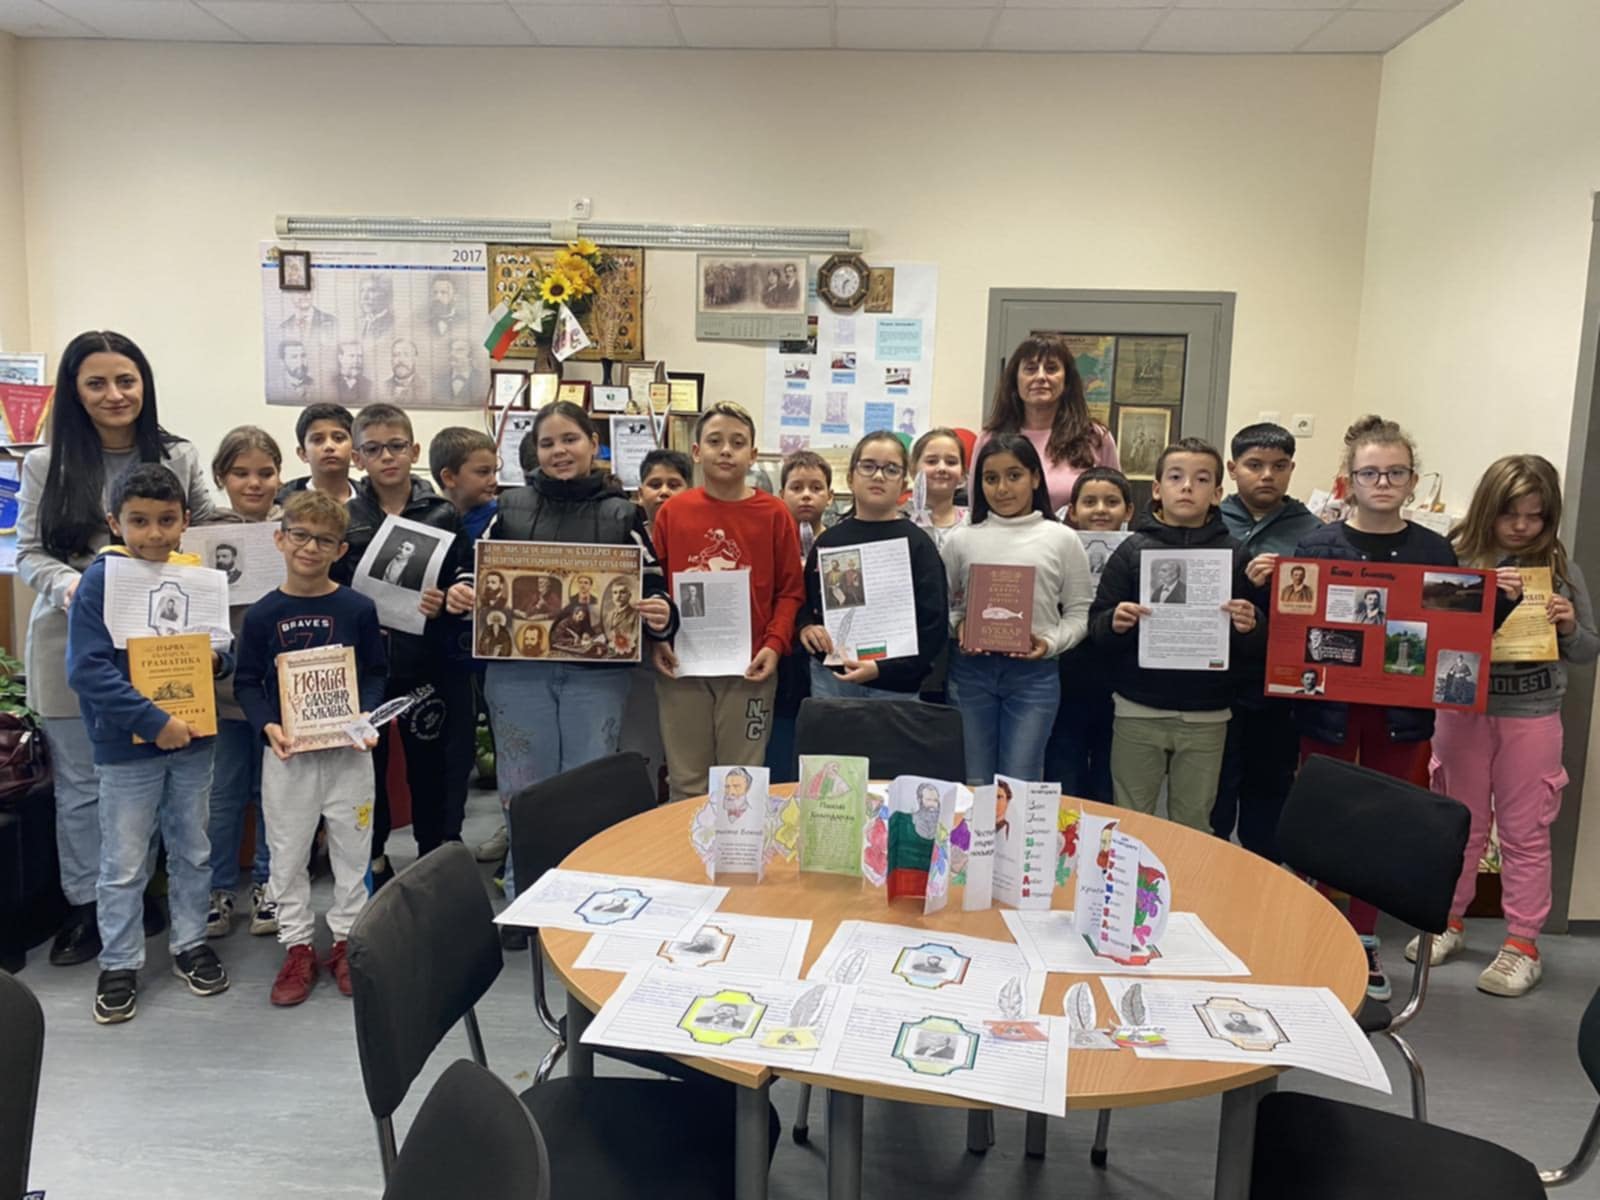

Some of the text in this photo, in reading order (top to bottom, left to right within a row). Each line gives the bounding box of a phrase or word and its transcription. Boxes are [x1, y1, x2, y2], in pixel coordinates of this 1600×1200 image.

[452, 249, 482, 263] 2017
[281, 619, 330, 632] BRAVES
[141, 656, 201, 668] ГРАМАТИКА
